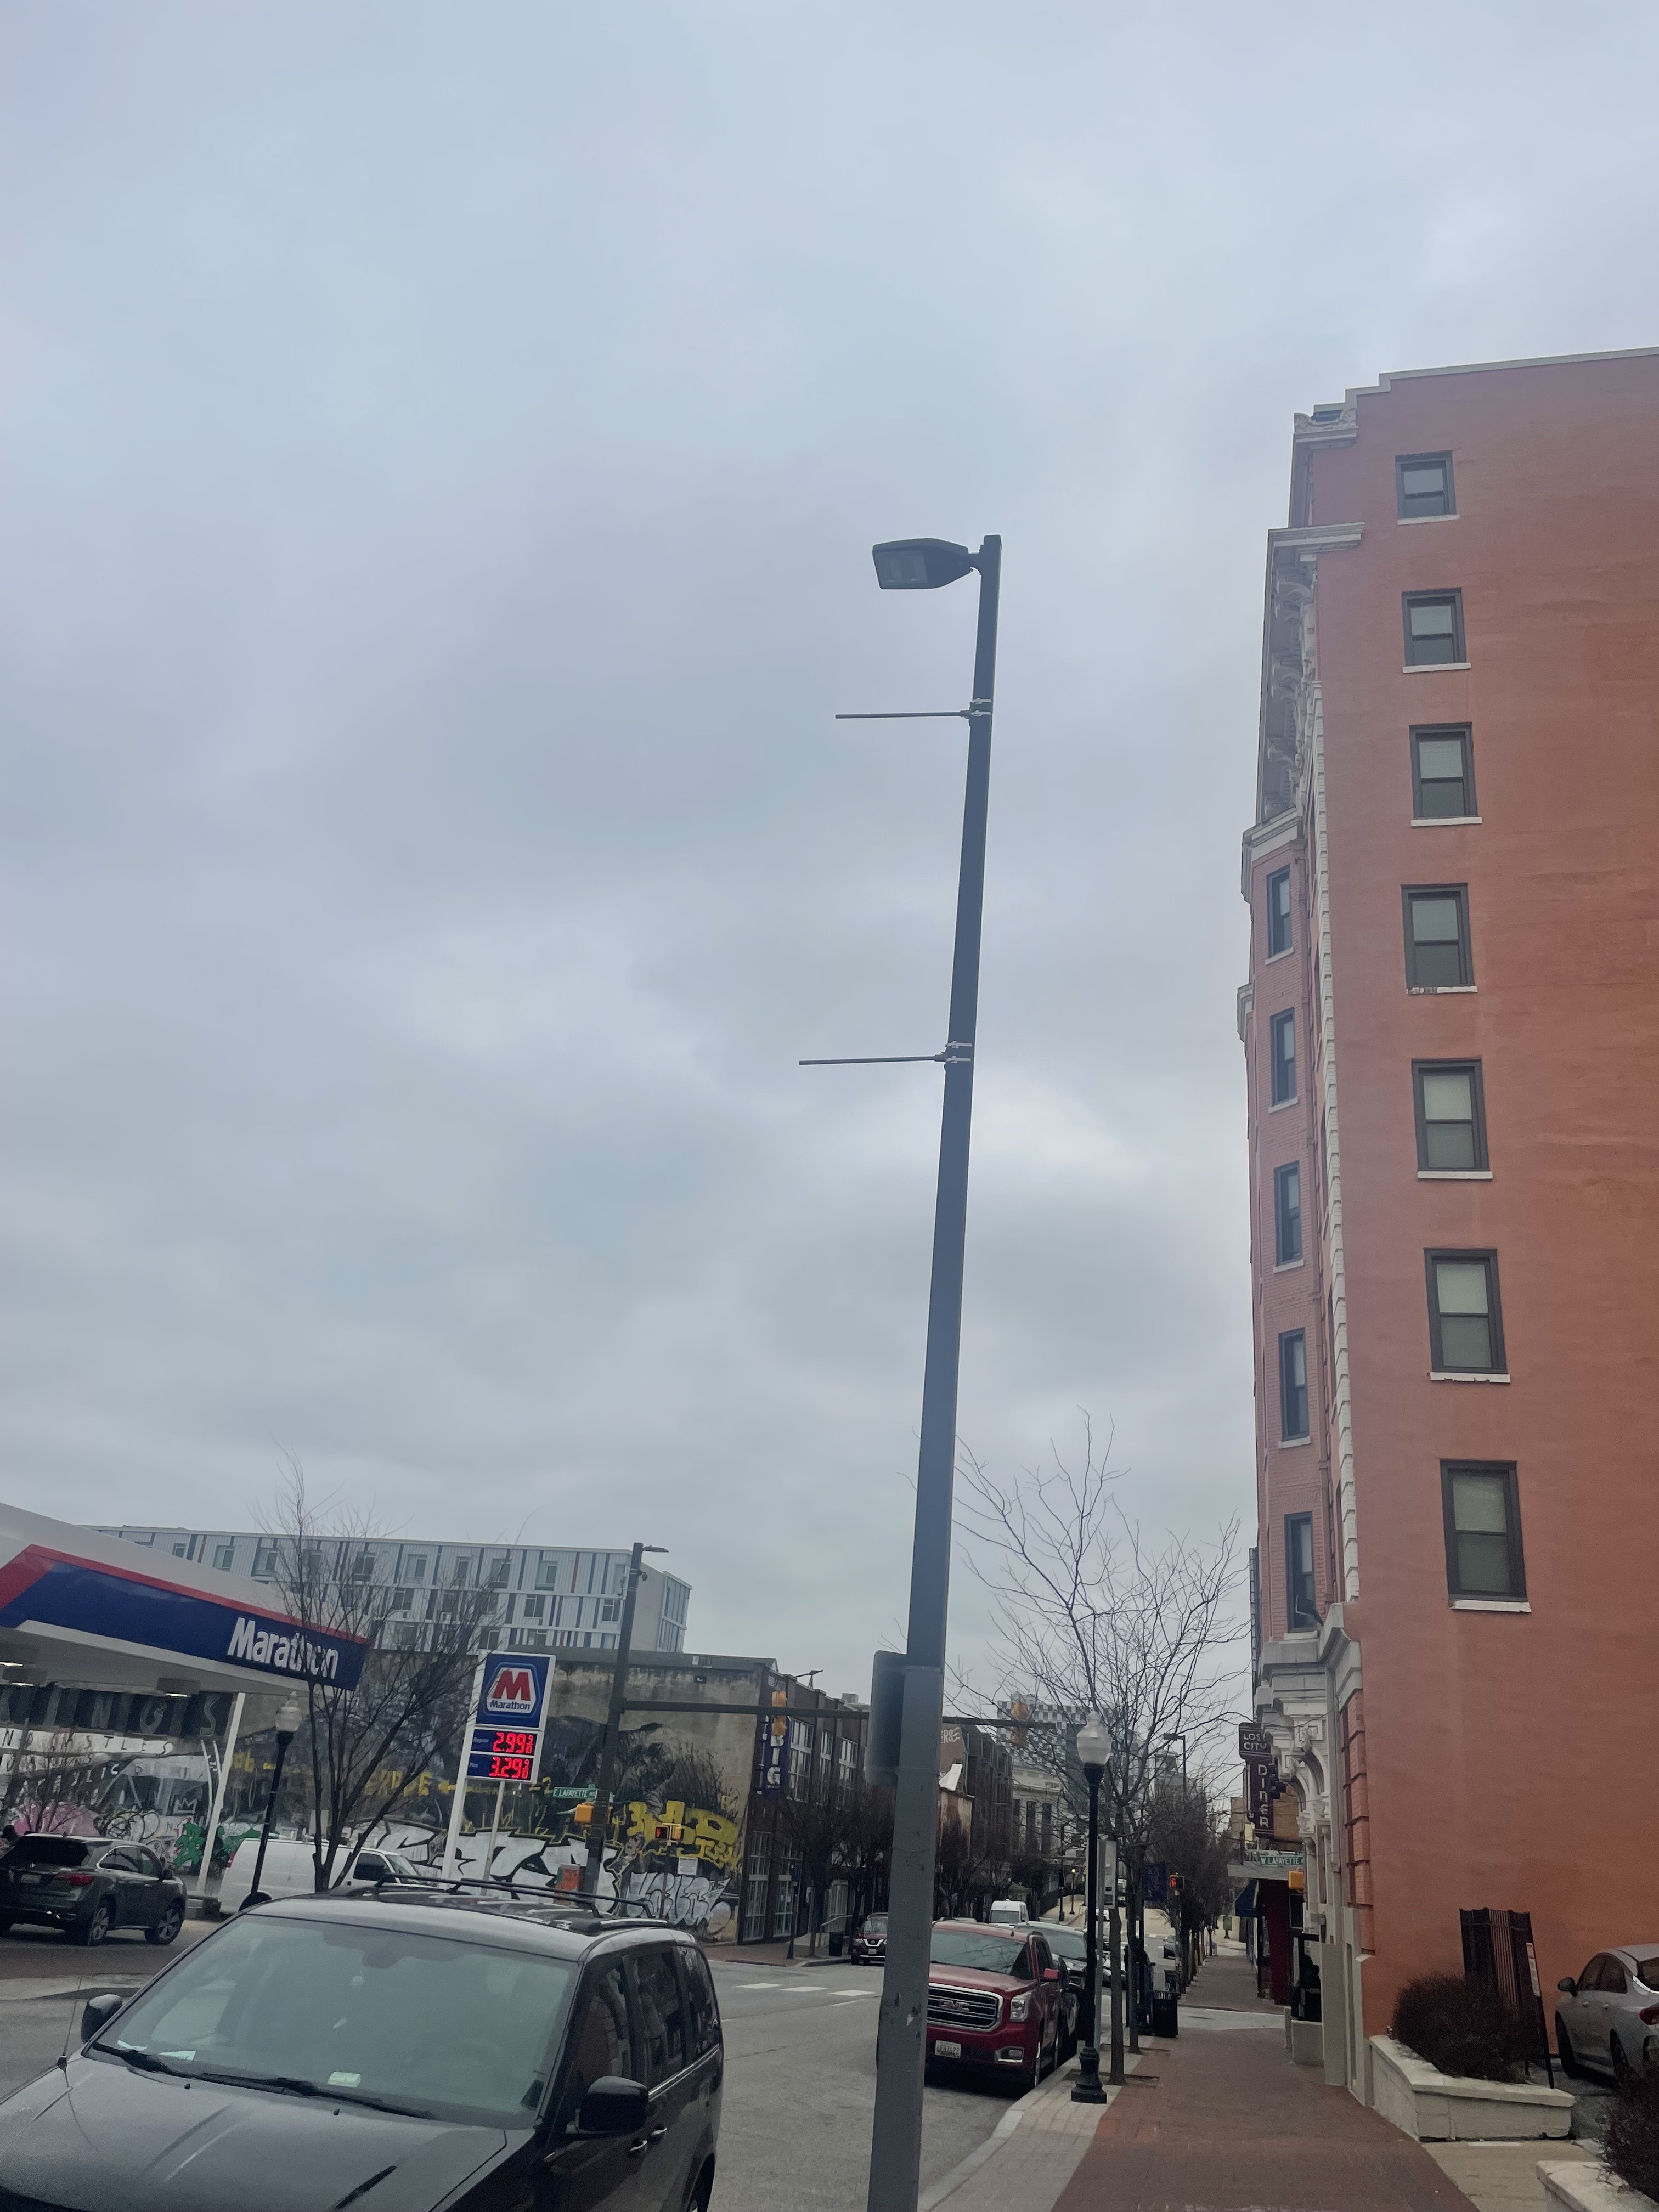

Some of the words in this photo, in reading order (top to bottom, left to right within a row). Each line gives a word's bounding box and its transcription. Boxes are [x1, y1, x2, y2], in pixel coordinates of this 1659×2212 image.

[227, 1617, 339, 1679] Marathon
[490, 1700, 531, 1711] Marathon
[1243, 1733, 1261, 1741] LOS
[558, 1789, 589, 1797] LAFAYETTE
[939, 1999, 970, 2012] GMC
